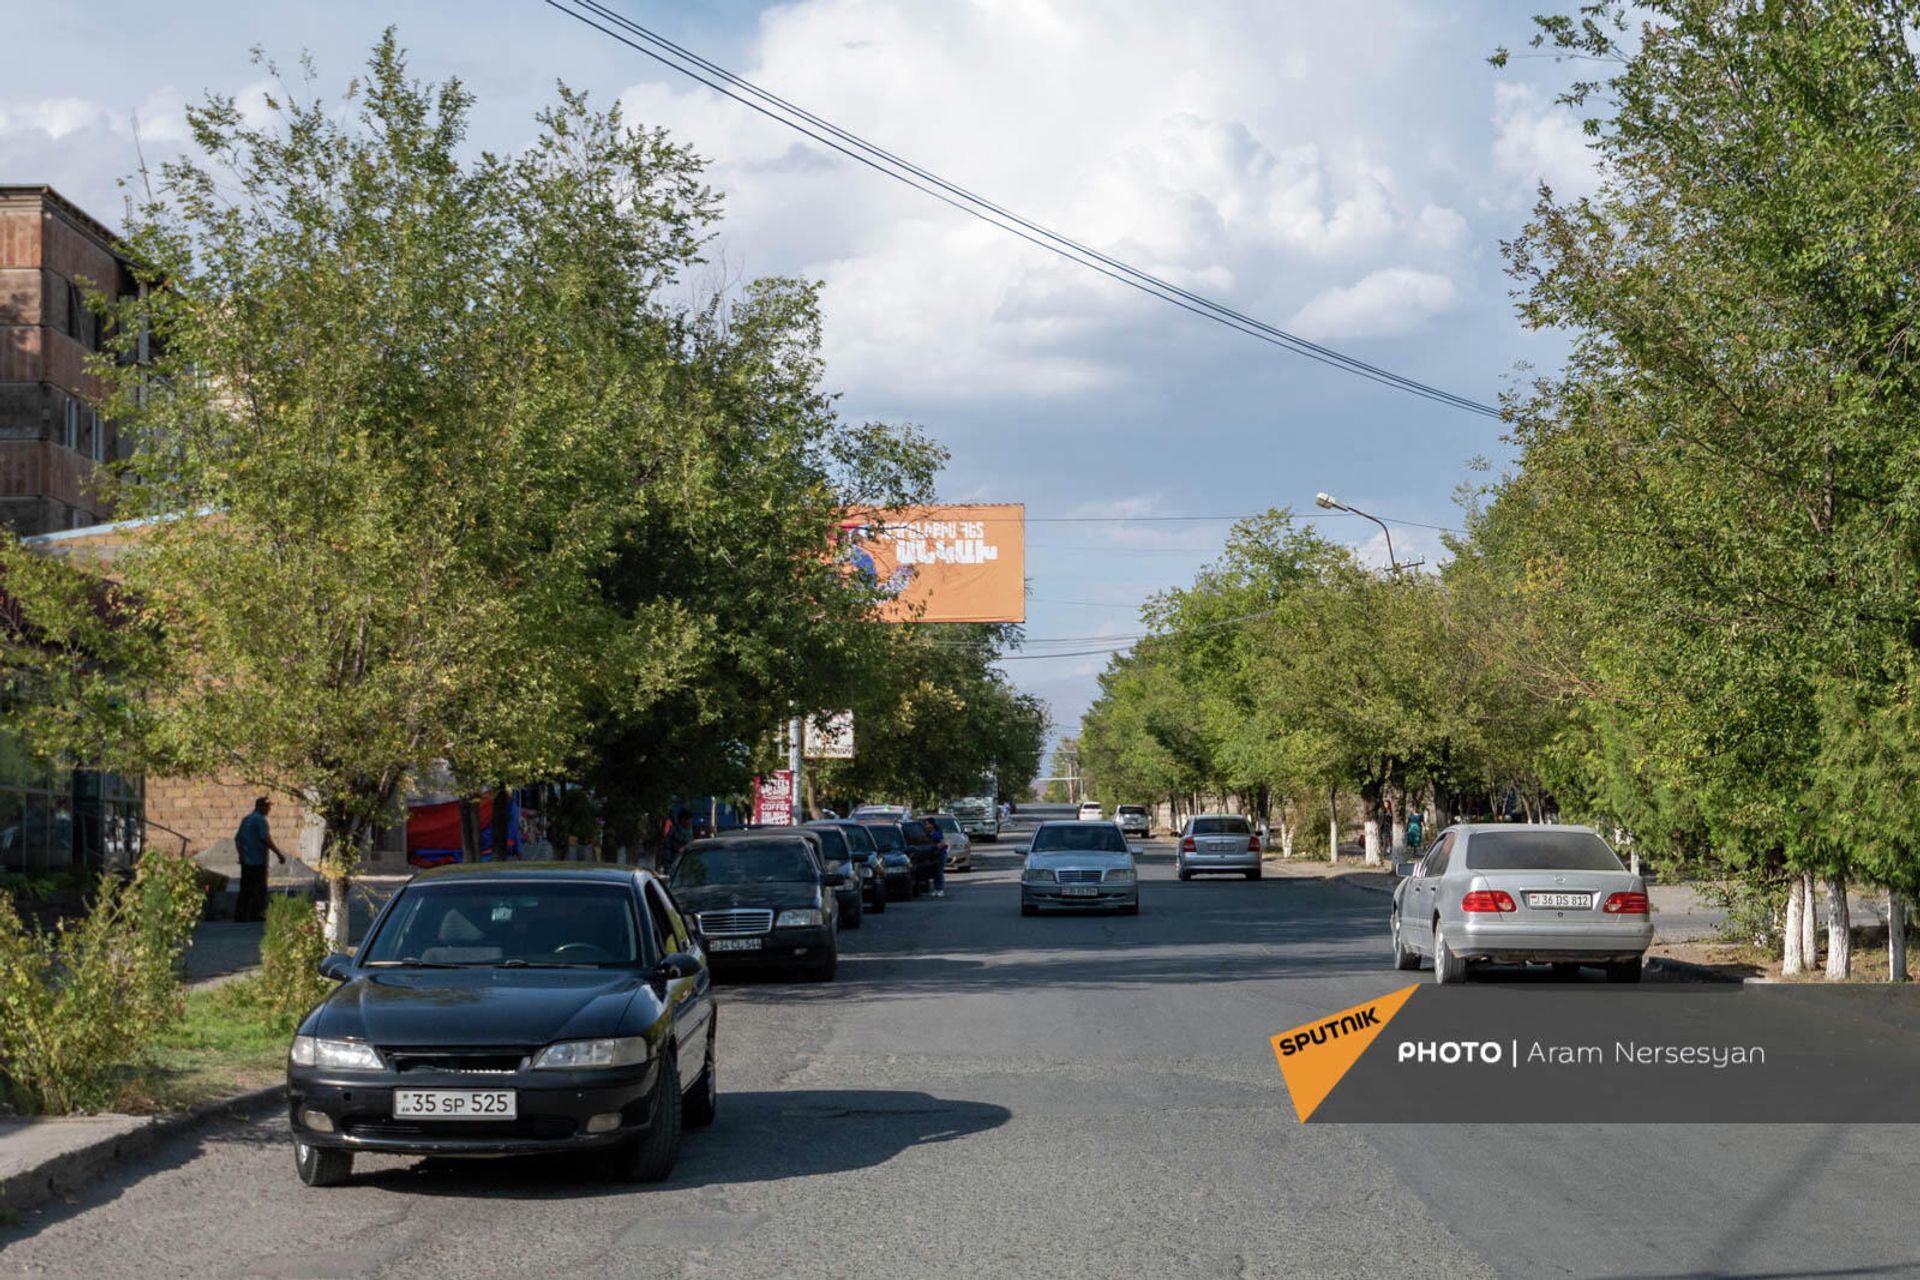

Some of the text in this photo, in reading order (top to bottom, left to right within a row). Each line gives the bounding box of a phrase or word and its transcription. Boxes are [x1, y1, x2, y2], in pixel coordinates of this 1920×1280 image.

[1542, 895, 1588, 906] 36 DS 812
[412, 1093, 508, 1113] 35 SP 525
